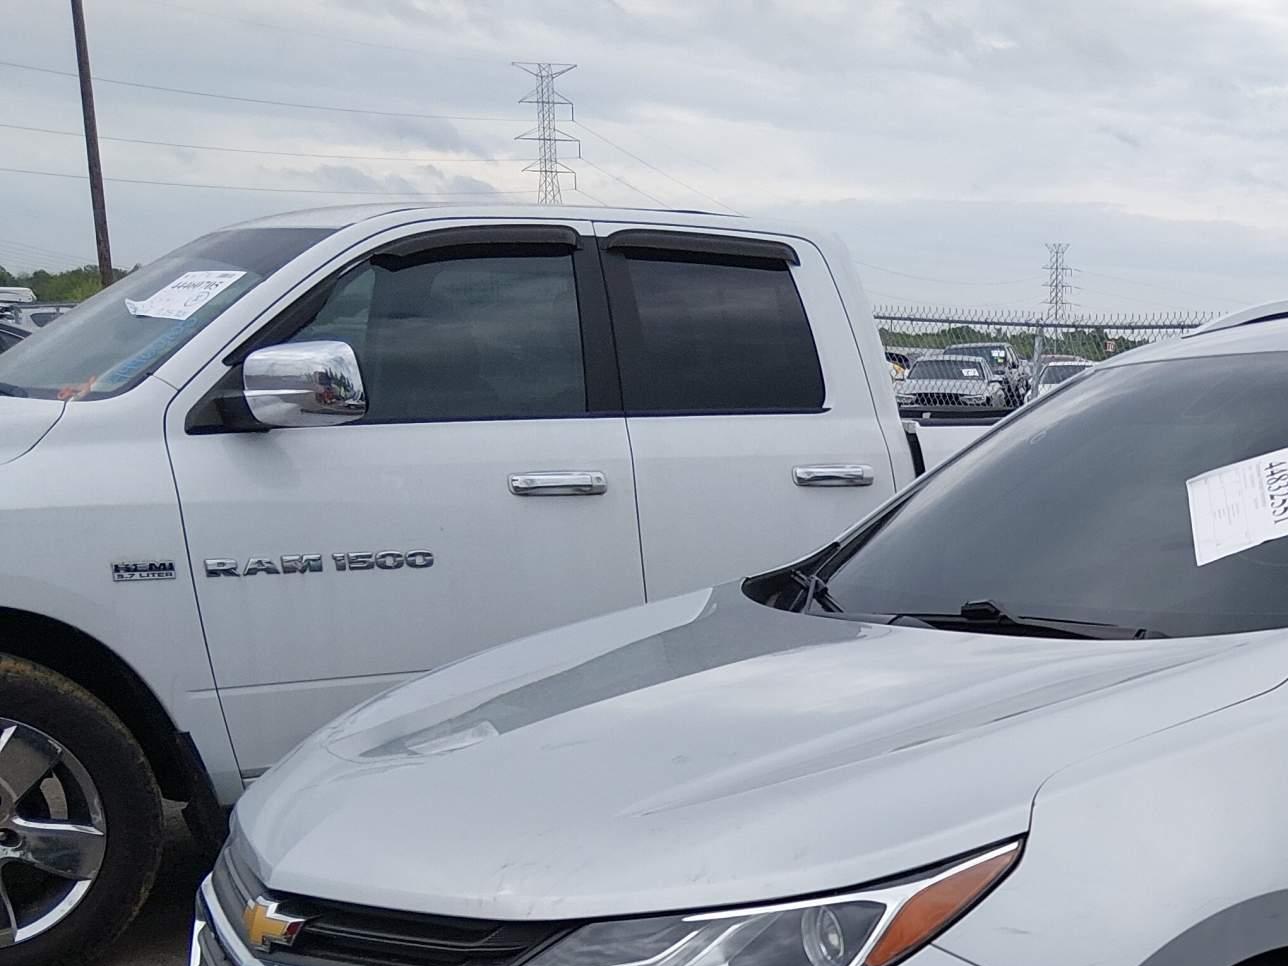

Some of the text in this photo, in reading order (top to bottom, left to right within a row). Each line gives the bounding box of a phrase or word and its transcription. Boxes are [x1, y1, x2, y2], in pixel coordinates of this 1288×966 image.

[113, 562, 175, 573] HEMI
[204, 550, 435, 577] RAM 1500
